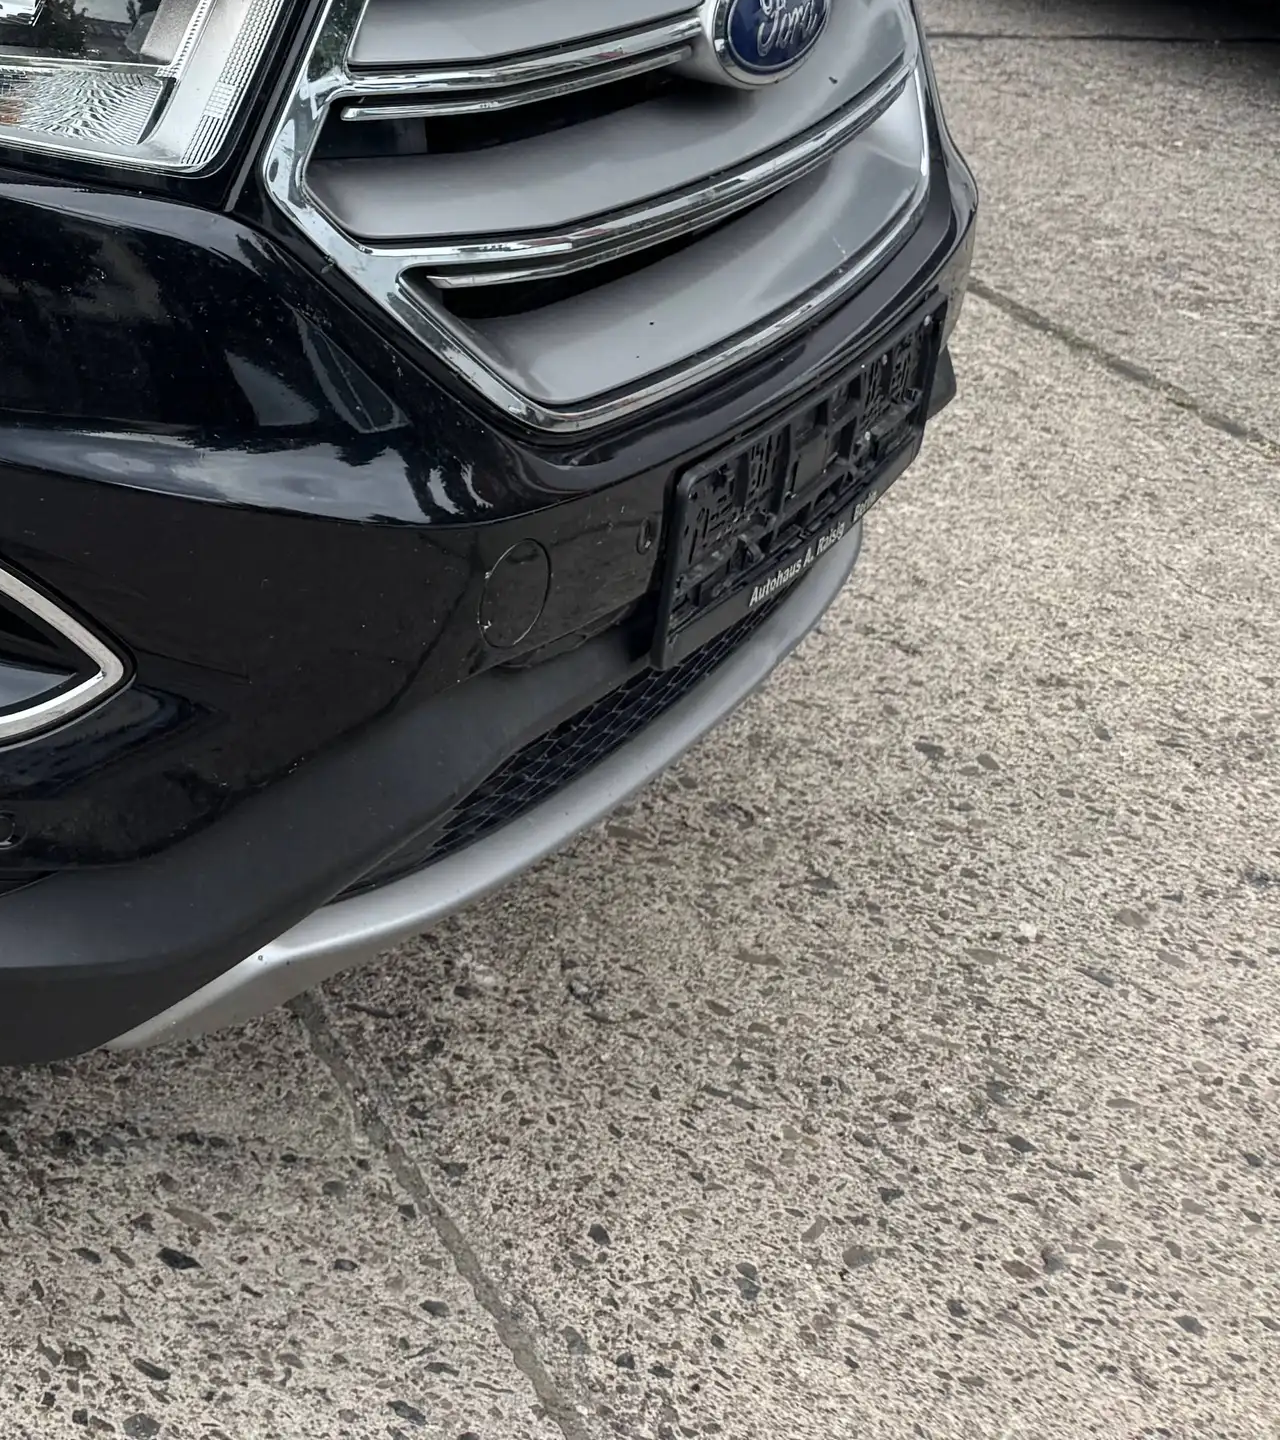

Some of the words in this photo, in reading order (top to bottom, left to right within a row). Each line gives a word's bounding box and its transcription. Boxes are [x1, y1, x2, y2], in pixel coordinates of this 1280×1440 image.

[748, 559, 802, 608] Autohaus
[803, 546, 815, 569] A.
[816, 522, 846, 556] Raisig
